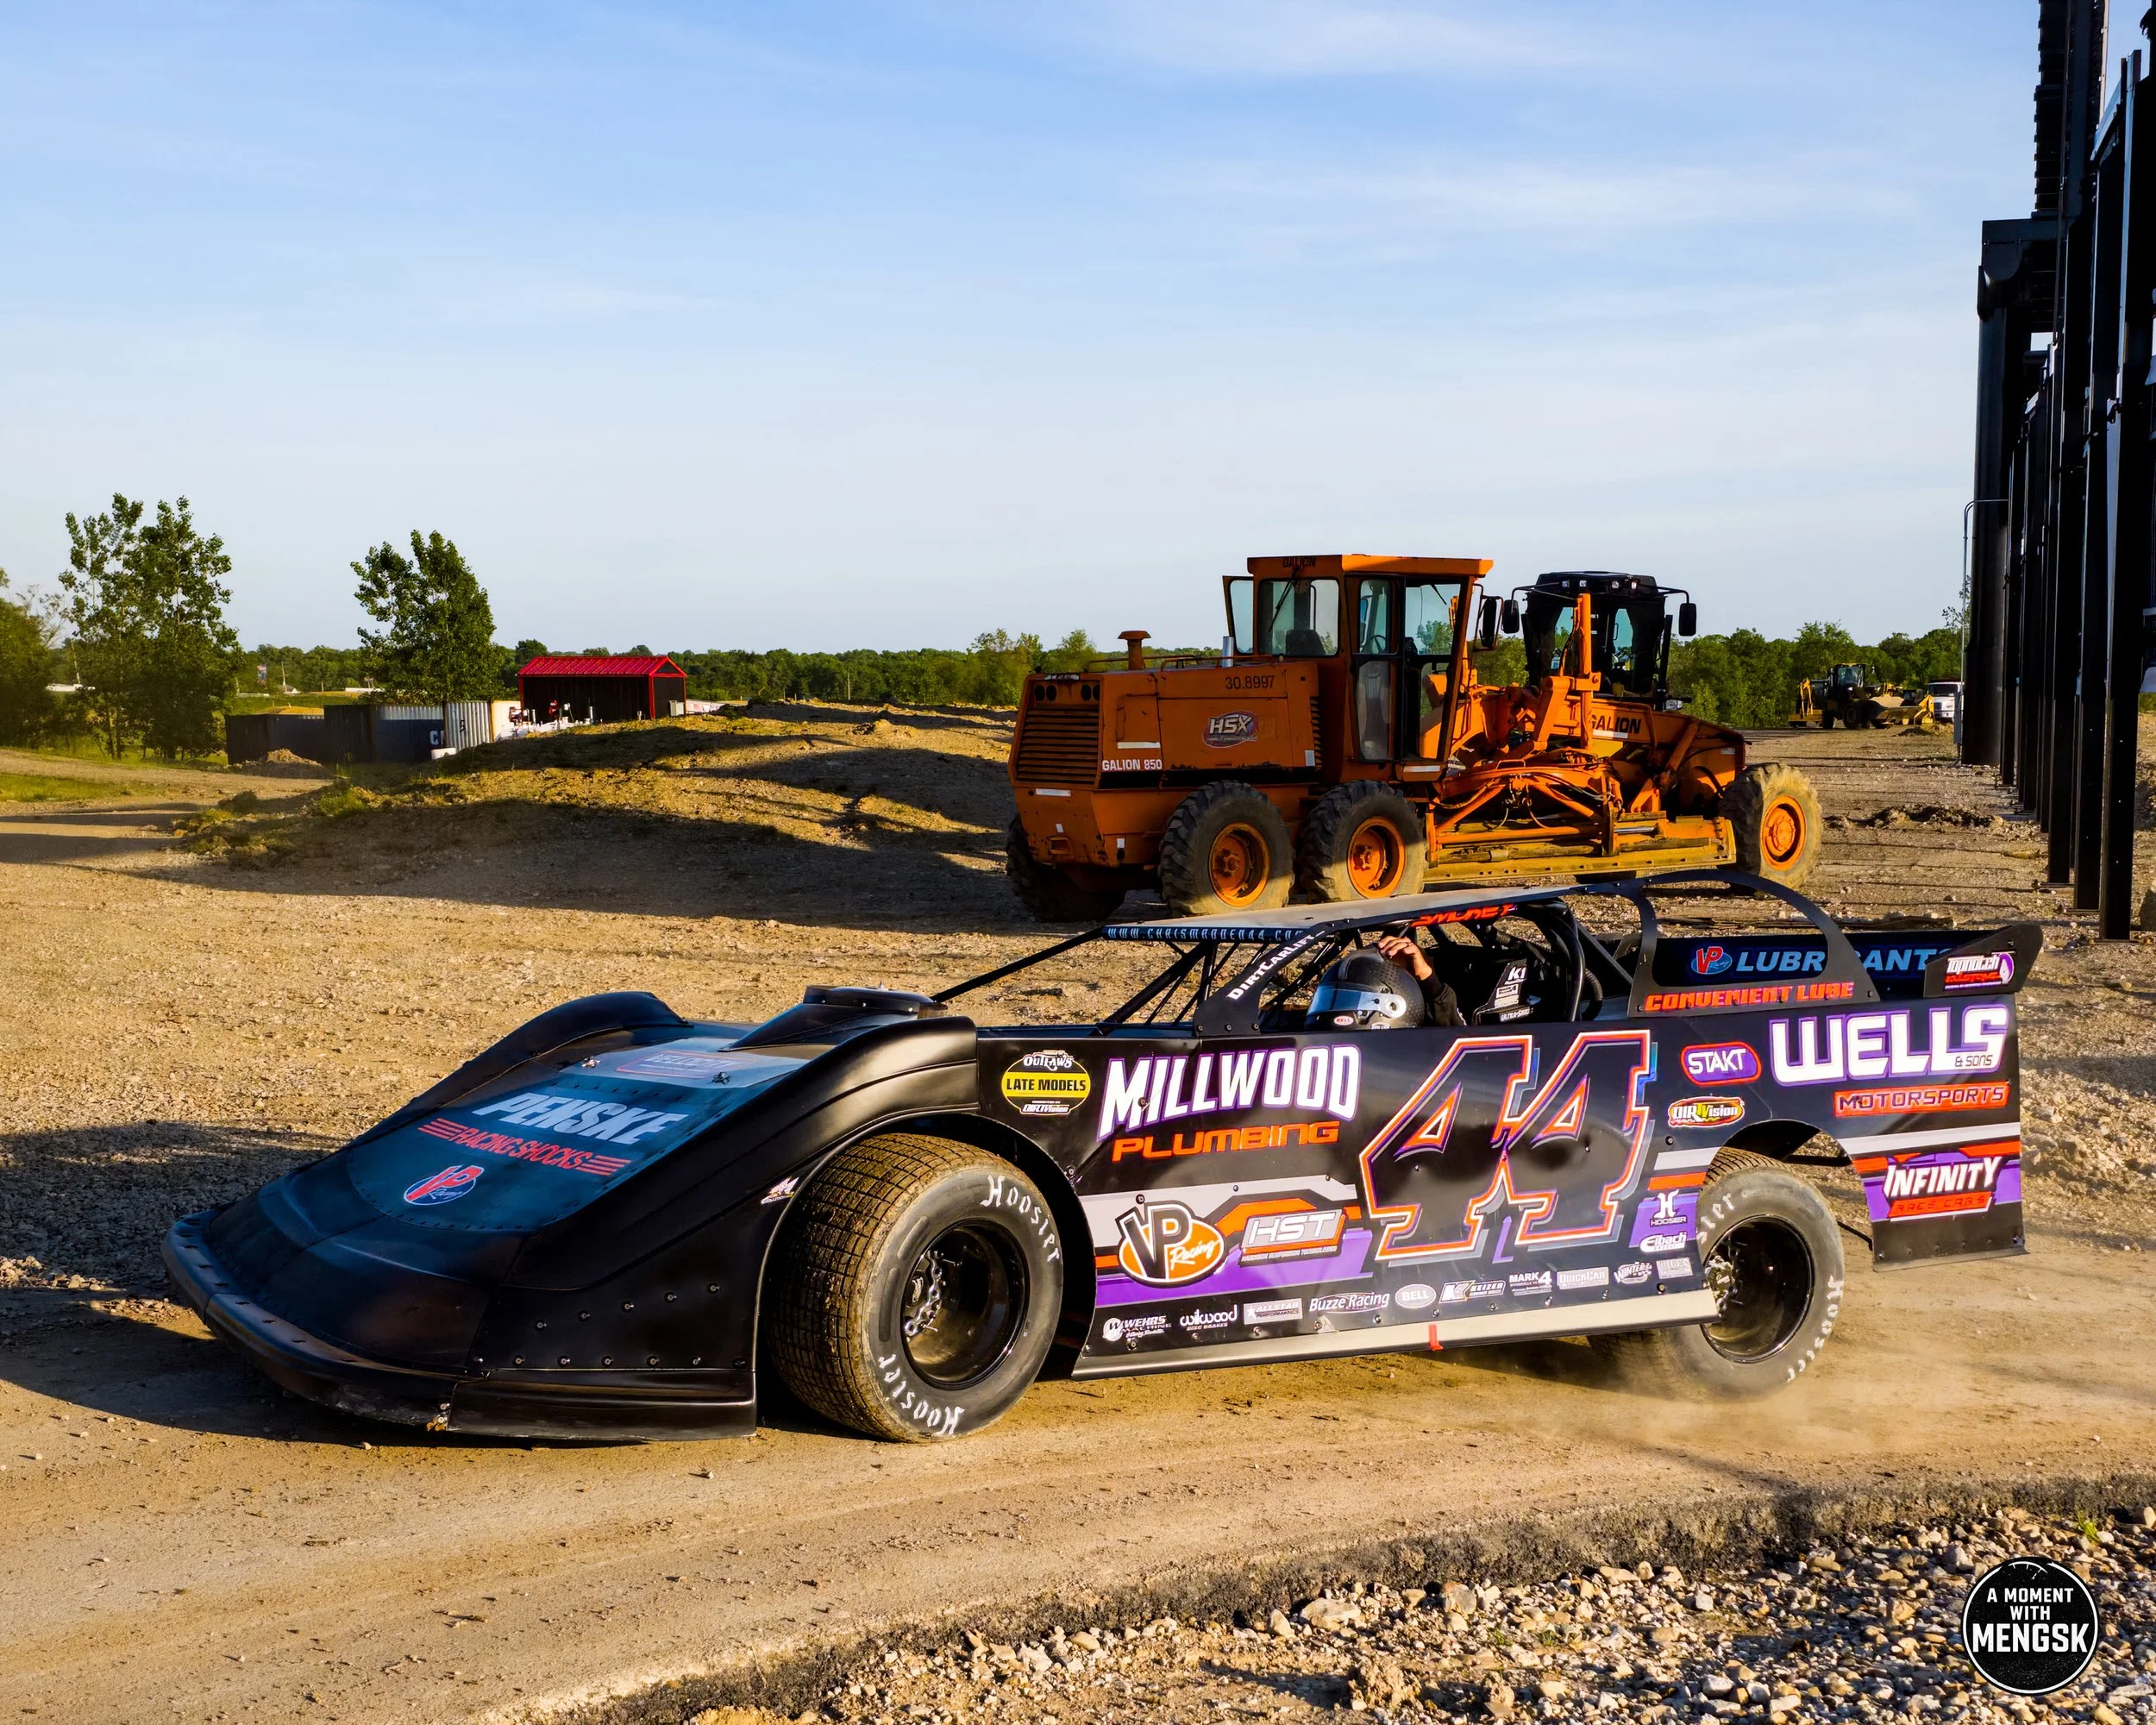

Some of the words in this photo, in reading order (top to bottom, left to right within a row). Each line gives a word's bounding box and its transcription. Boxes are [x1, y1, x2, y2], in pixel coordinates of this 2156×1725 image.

[1225, 675, 1275, 690] 30.8997
[1208, 716, 1252, 735] HSX
[1101, 759, 1141, 771] GALION
[1144, 759, 1163, 770] 850
[1736, 949, 1951, 972] LUBRANT
[1645, 986, 1793, 1012] CONVENIENT
[1796, 982, 1854, 1000] LUBE
[1770, 1004, 2009, 1087] WELLS
[1688, 1048, 1746, 1075] STAKT
[1954, 1056, 1964, 1068] &
[1965, 1055, 1993, 1067] SONS
[1006, 1078, 1035, 1091] LATE
[1037, 1079, 1087, 1092] MODELS
[1097, 1044, 1362, 1142] MILLWOOD
[1839, 1086, 2005, 1112] MOTORSPORTS
[472, 1092, 689, 1145] PENSKE
[448, 1126, 523, 1158] RACING
[509, 1139, 593, 1170] SHOCKS
[1112, 1120, 1340, 1162] PLUMBING
[1359, 1029, 1654, 1264] 44
[1883, 1156, 2002, 1199] INFINITY
[1247, 1211, 1337, 1245] HST
[1650, 1216, 1687, 1227] HOOSIER
[1119, 1203, 1194, 1281] VP
[1169, 1239, 1221, 1270] Racing
[1509, 1271, 1539, 1283] MARK
[1538, 1270, 1552, 1286] 4
[1309, 1297, 1347, 1312] Buzze
[1348, 1292, 1390, 1308] Racing
[1401, 1289, 1430, 1302] BELL
[1180, 1304, 1238, 1327] wilwood
